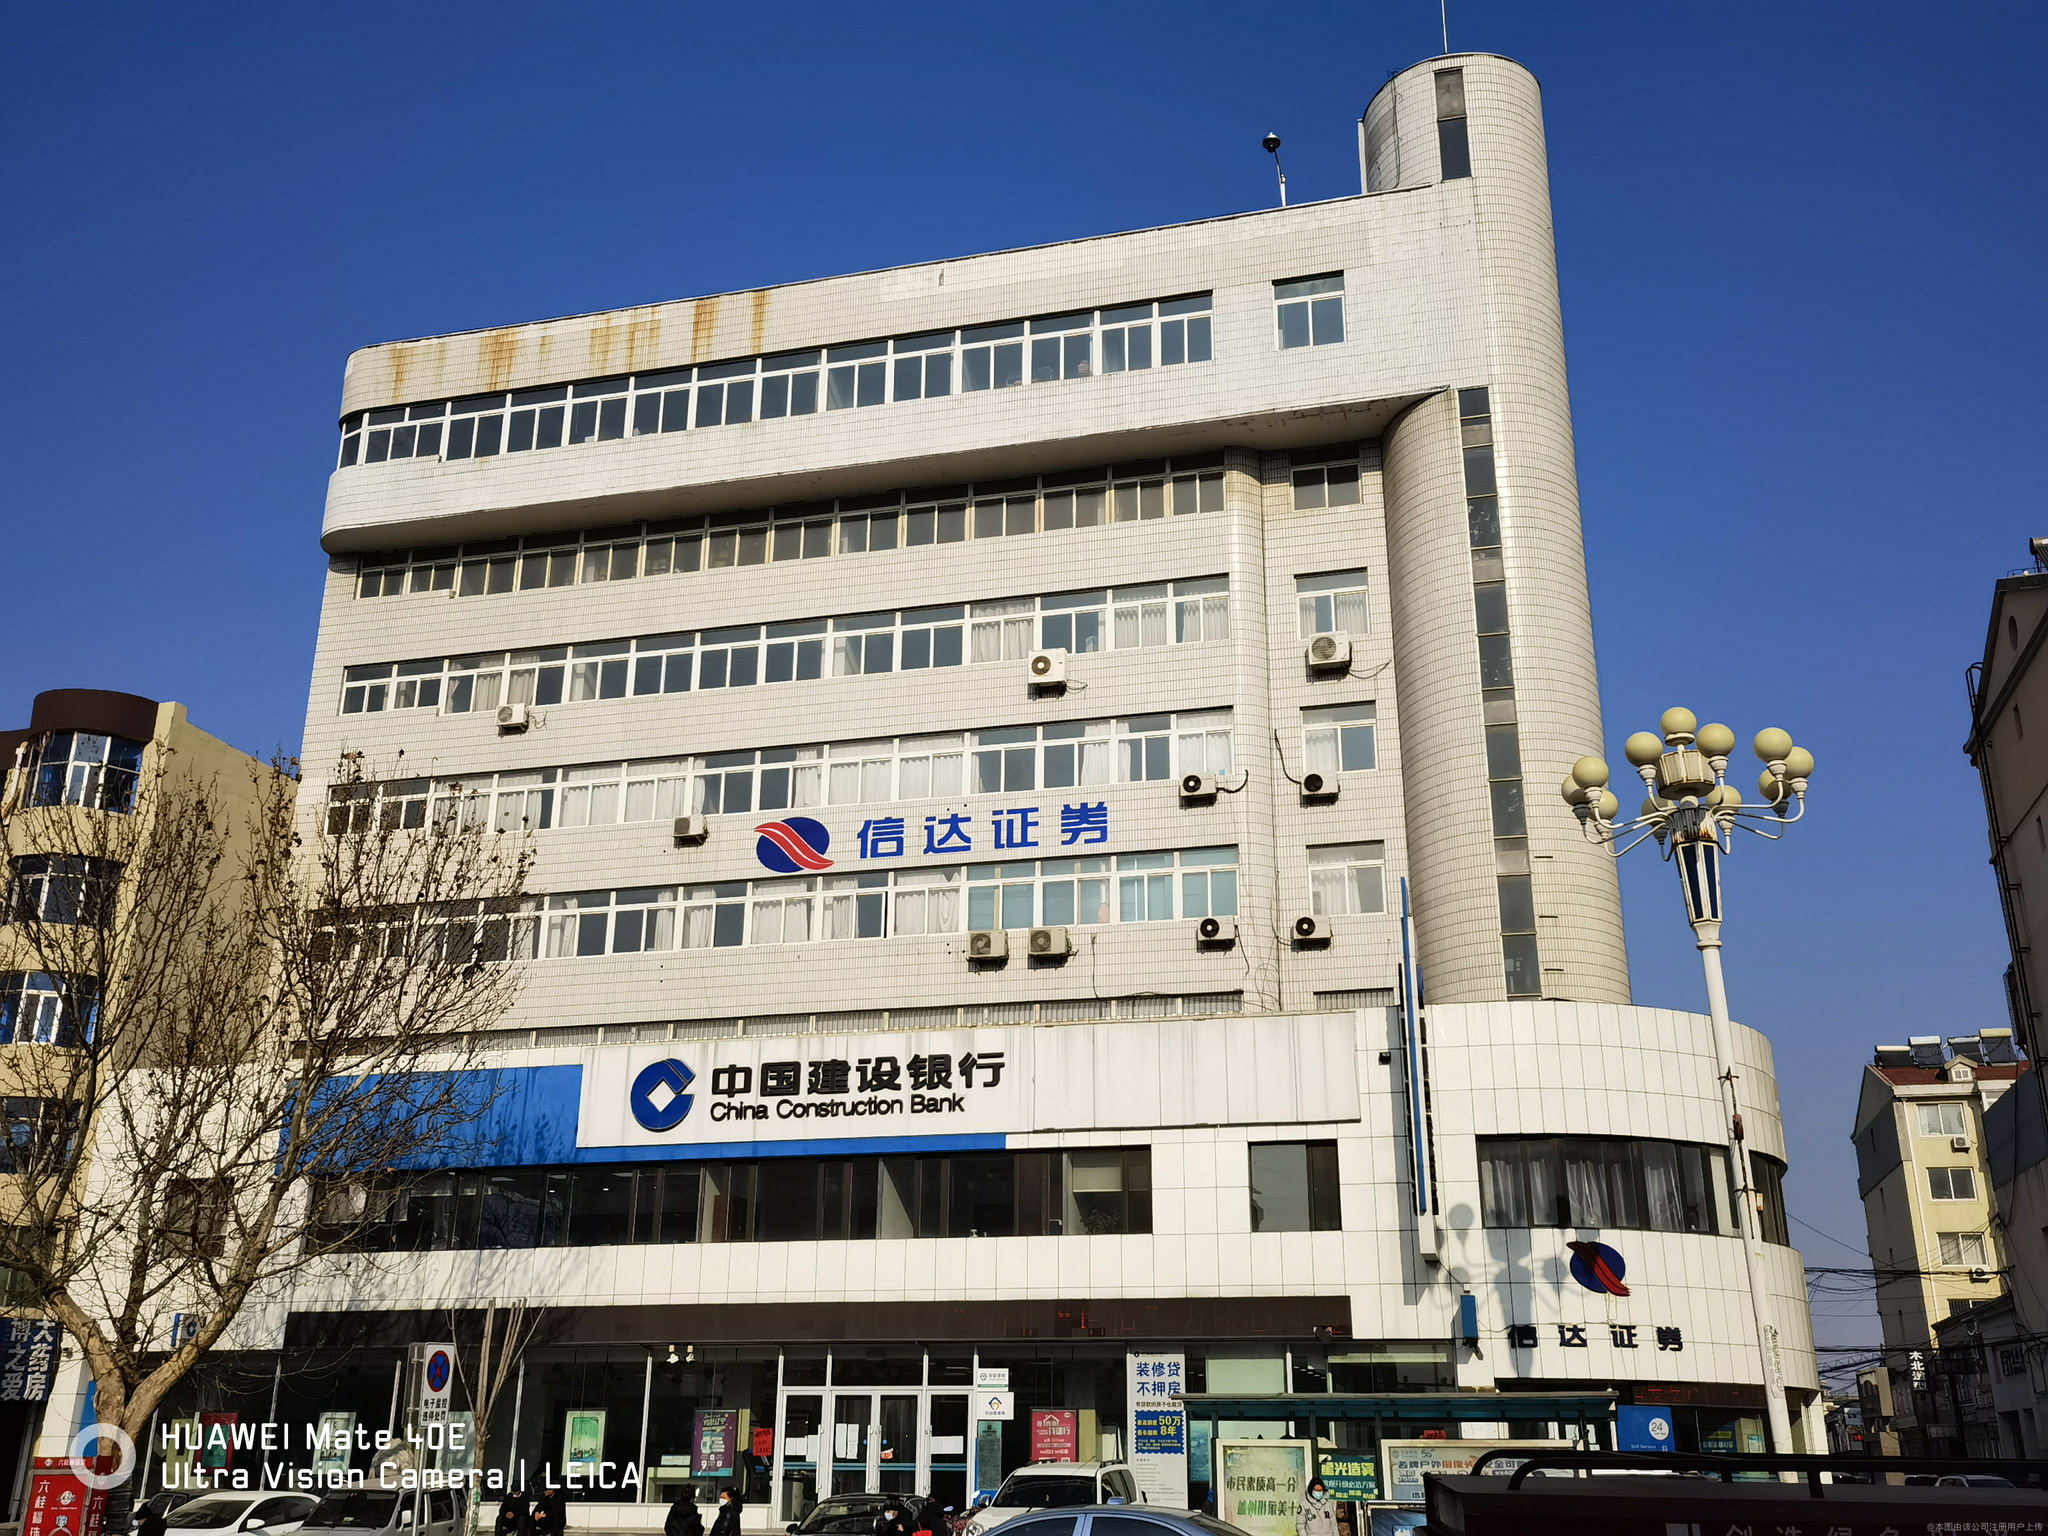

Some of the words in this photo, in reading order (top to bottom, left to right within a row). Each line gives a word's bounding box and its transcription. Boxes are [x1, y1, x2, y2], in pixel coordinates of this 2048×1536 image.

[857, 801, 1109, 859] 信达证券
[711, 1052, 1005, 1098] 中国建设银行
[710, 1100, 769, 1122] China
[776, 1095, 904, 1119] Construction
[911, 1093, 966, 1114] Bank
[1507, 1324, 1684, 1352] 信达证券
[23, 1317, 56, 1401] 大药房
[1136, 1361, 1181, 1377] 装修贷
[1909, 1350, 1928, 1391] 木北造型
[1136, 1380, 1181, 1397] 不押房
[424, 1398, 448, 1409] 电子监控
[422, 1410, 447, 1422] 违停处罚
[1158, 1415, 1181, 1426] 50万
[1160, 1425, 1177, 1437] 8年
[1651, 1422, 1663, 1432] 24
[1226, 1476, 1296, 1492] 市民素质高一分
